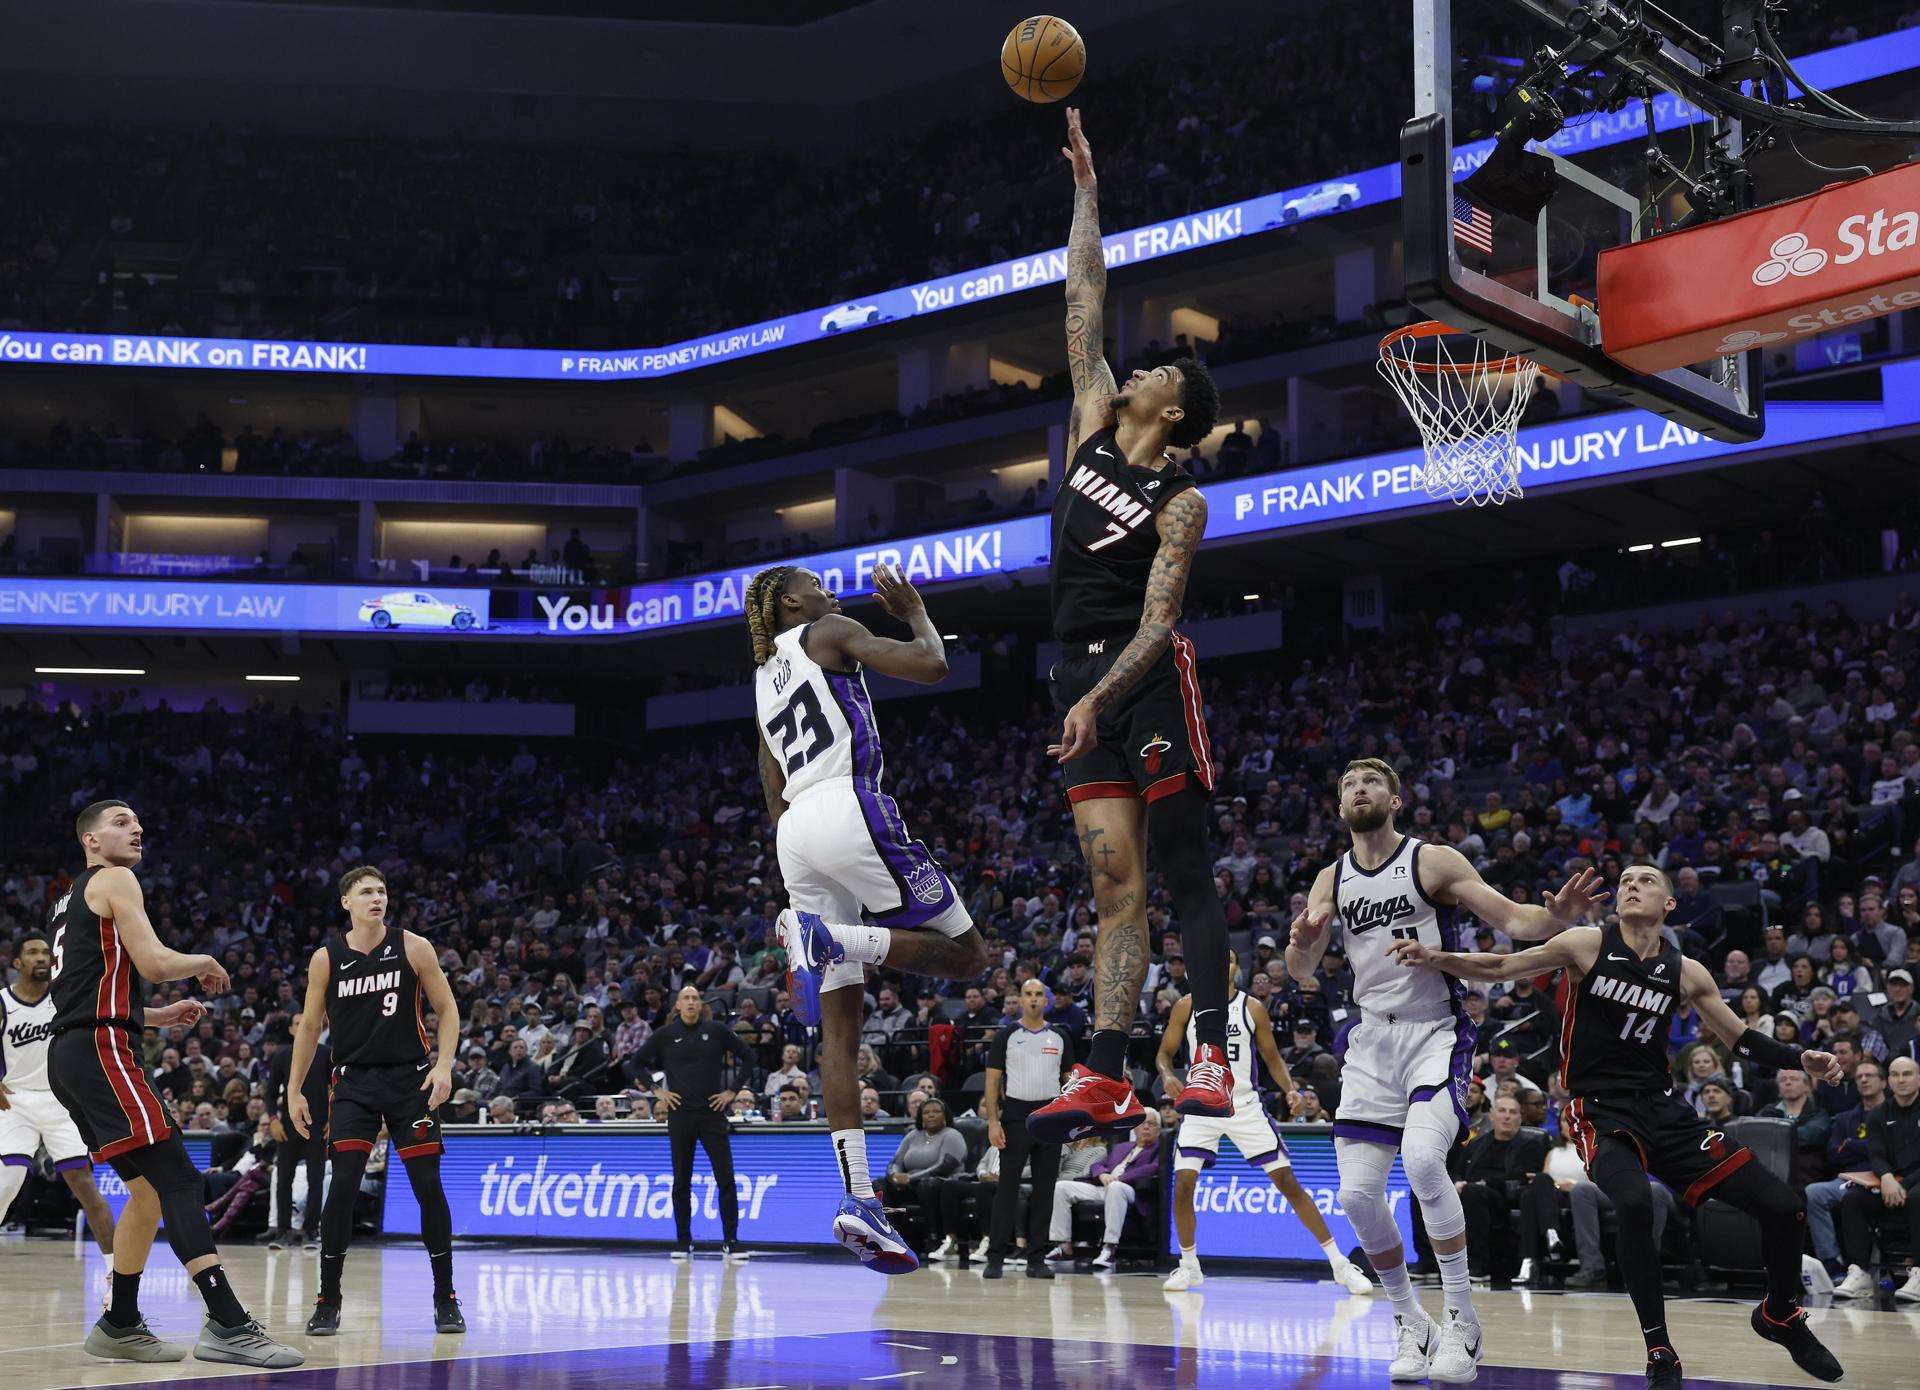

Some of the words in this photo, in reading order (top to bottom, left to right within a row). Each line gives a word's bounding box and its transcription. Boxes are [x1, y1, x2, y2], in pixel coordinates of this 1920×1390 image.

[1591, 101, 1669, 139] INJUY
[911, 287, 954, 312] You
[961, 272, 1004, 300] can
[1011, 250, 1068, 288] BAN
[1133, 207, 1242, 258] FRANK!
[1787, 291, 1920, 333] State
[51, 340, 104, 362] can
[112, 338, 200, 365] BANK
[207, 346, 244, 366] on
[252, 343, 366, 370] FRANK!
[578, 356, 638, 373] FRANK
[642, 345, 699, 371] PENNEY
[701, 334, 751, 359] INJURY
[751, 324, 785, 347] LAW
[1068, 463, 1152, 530] MIAMI
[1262, 472, 1365, 516] FRANK
[1087, 521, 1129, 552] 7
[537, 595, 614, 632] You
[626, 595, 682, 628] can
[855, 530, 1002, 591] FRANK!
[104, 592, 210, 618] INJURY
[215, 594, 286, 619] LAW
[765, 679, 835, 778] 23
[1341, 894, 1416, 936] Kings
[337, 970, 401, 998] MIAMI
[1589, 975, 1673, 1016] MIAMI
[381, 992, 398, 1017] 9
[7, 1020, 56, 1049] King
[1618, 1011, 1659, 1045] 14
[1193, 1176, 1406, 1216] ticketar
